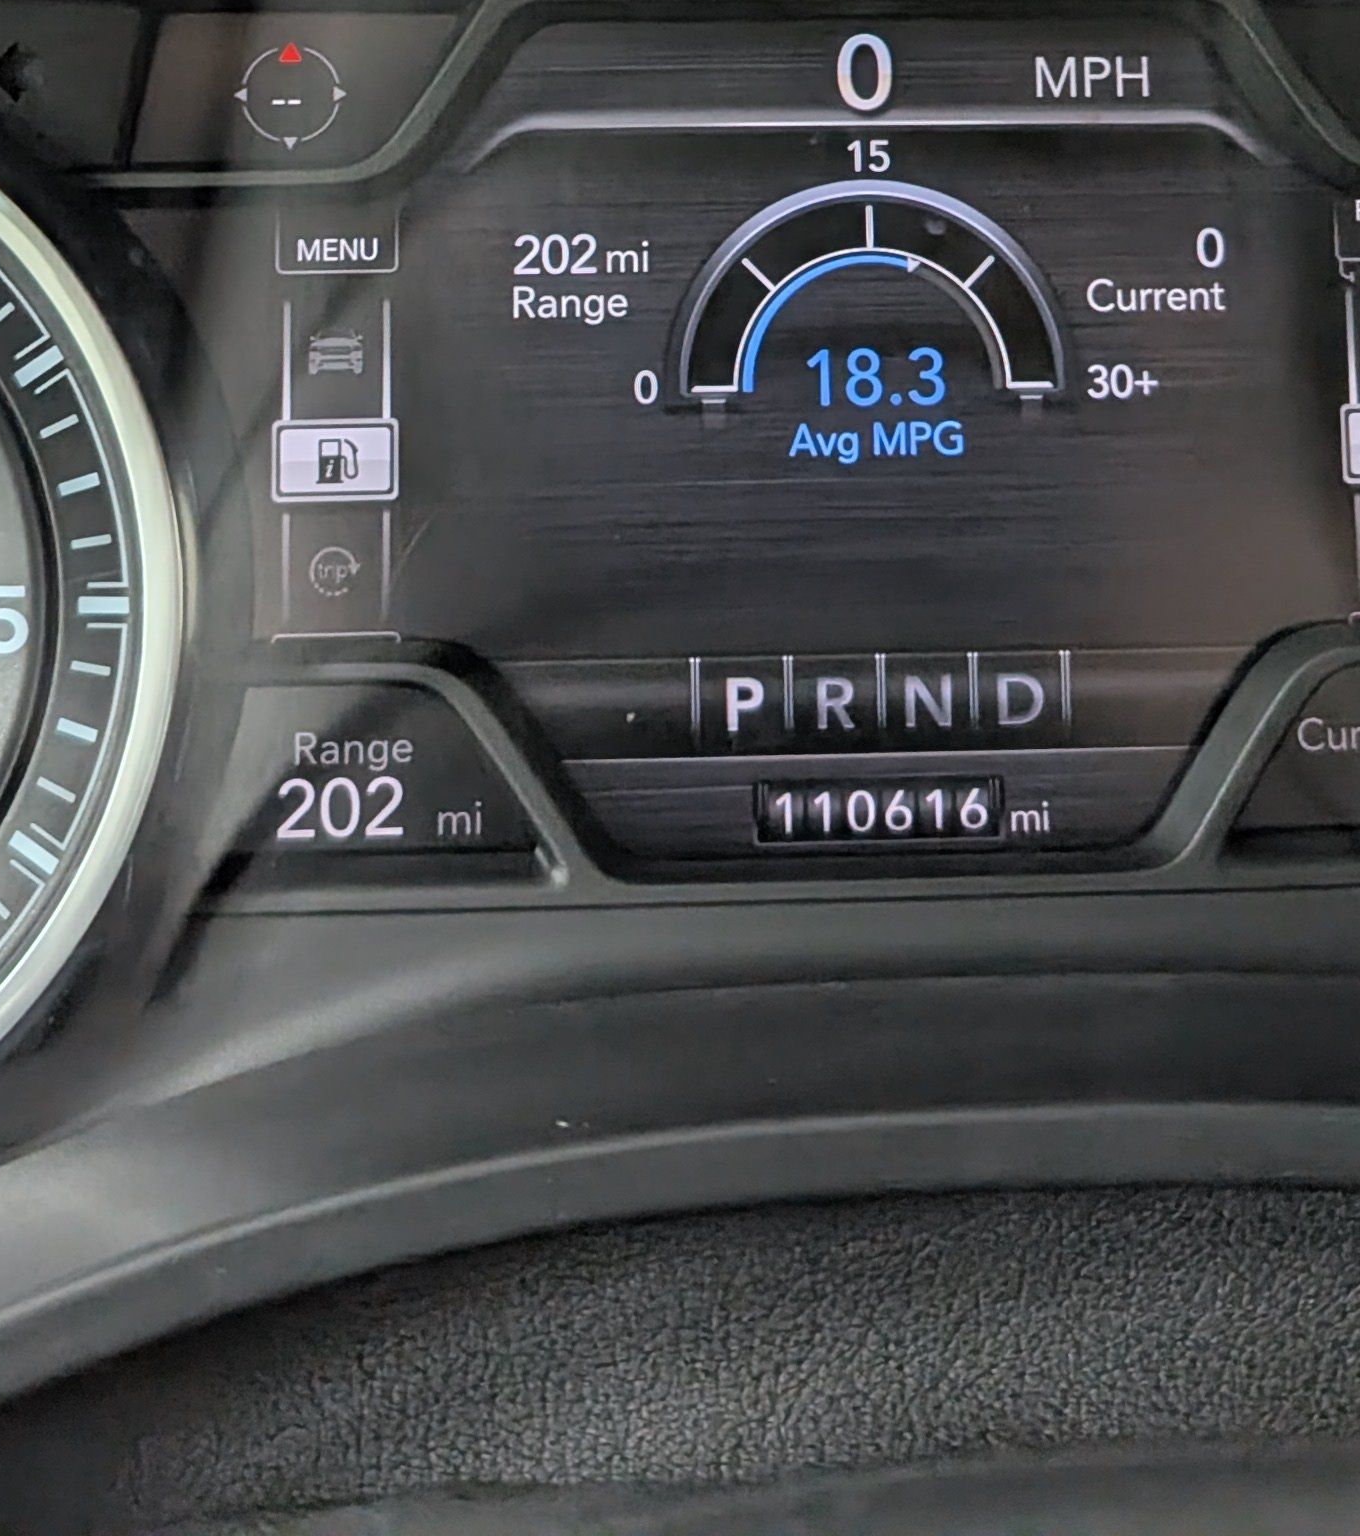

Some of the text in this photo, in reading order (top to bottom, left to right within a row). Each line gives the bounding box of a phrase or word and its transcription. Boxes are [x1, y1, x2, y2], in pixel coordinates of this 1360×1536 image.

[833, 33, 1150, 115] 0 MPH
[847, 139, 891, 173] 15
[297, 237, 378, 262] MENU
[513, 233, 649, 275] 202 mi
[1196, 227, 1225, 268] 0
[512, 285, 629, 326] Range
[1086, 278, 1226, 313] Current
[633, 369, 658, 405] 0
[806, 346, 946, 408] 18.3
[1087, 363, 1159, 399] 30+
[788, 420, 964, 465] Avg MPG
[725, 673, 1045, 732] P R N D
[292, 730, 415, 770] Range
[276, 775, 482, 841] 202 mi
[775, 787, 1050, 833] 110616 mi
